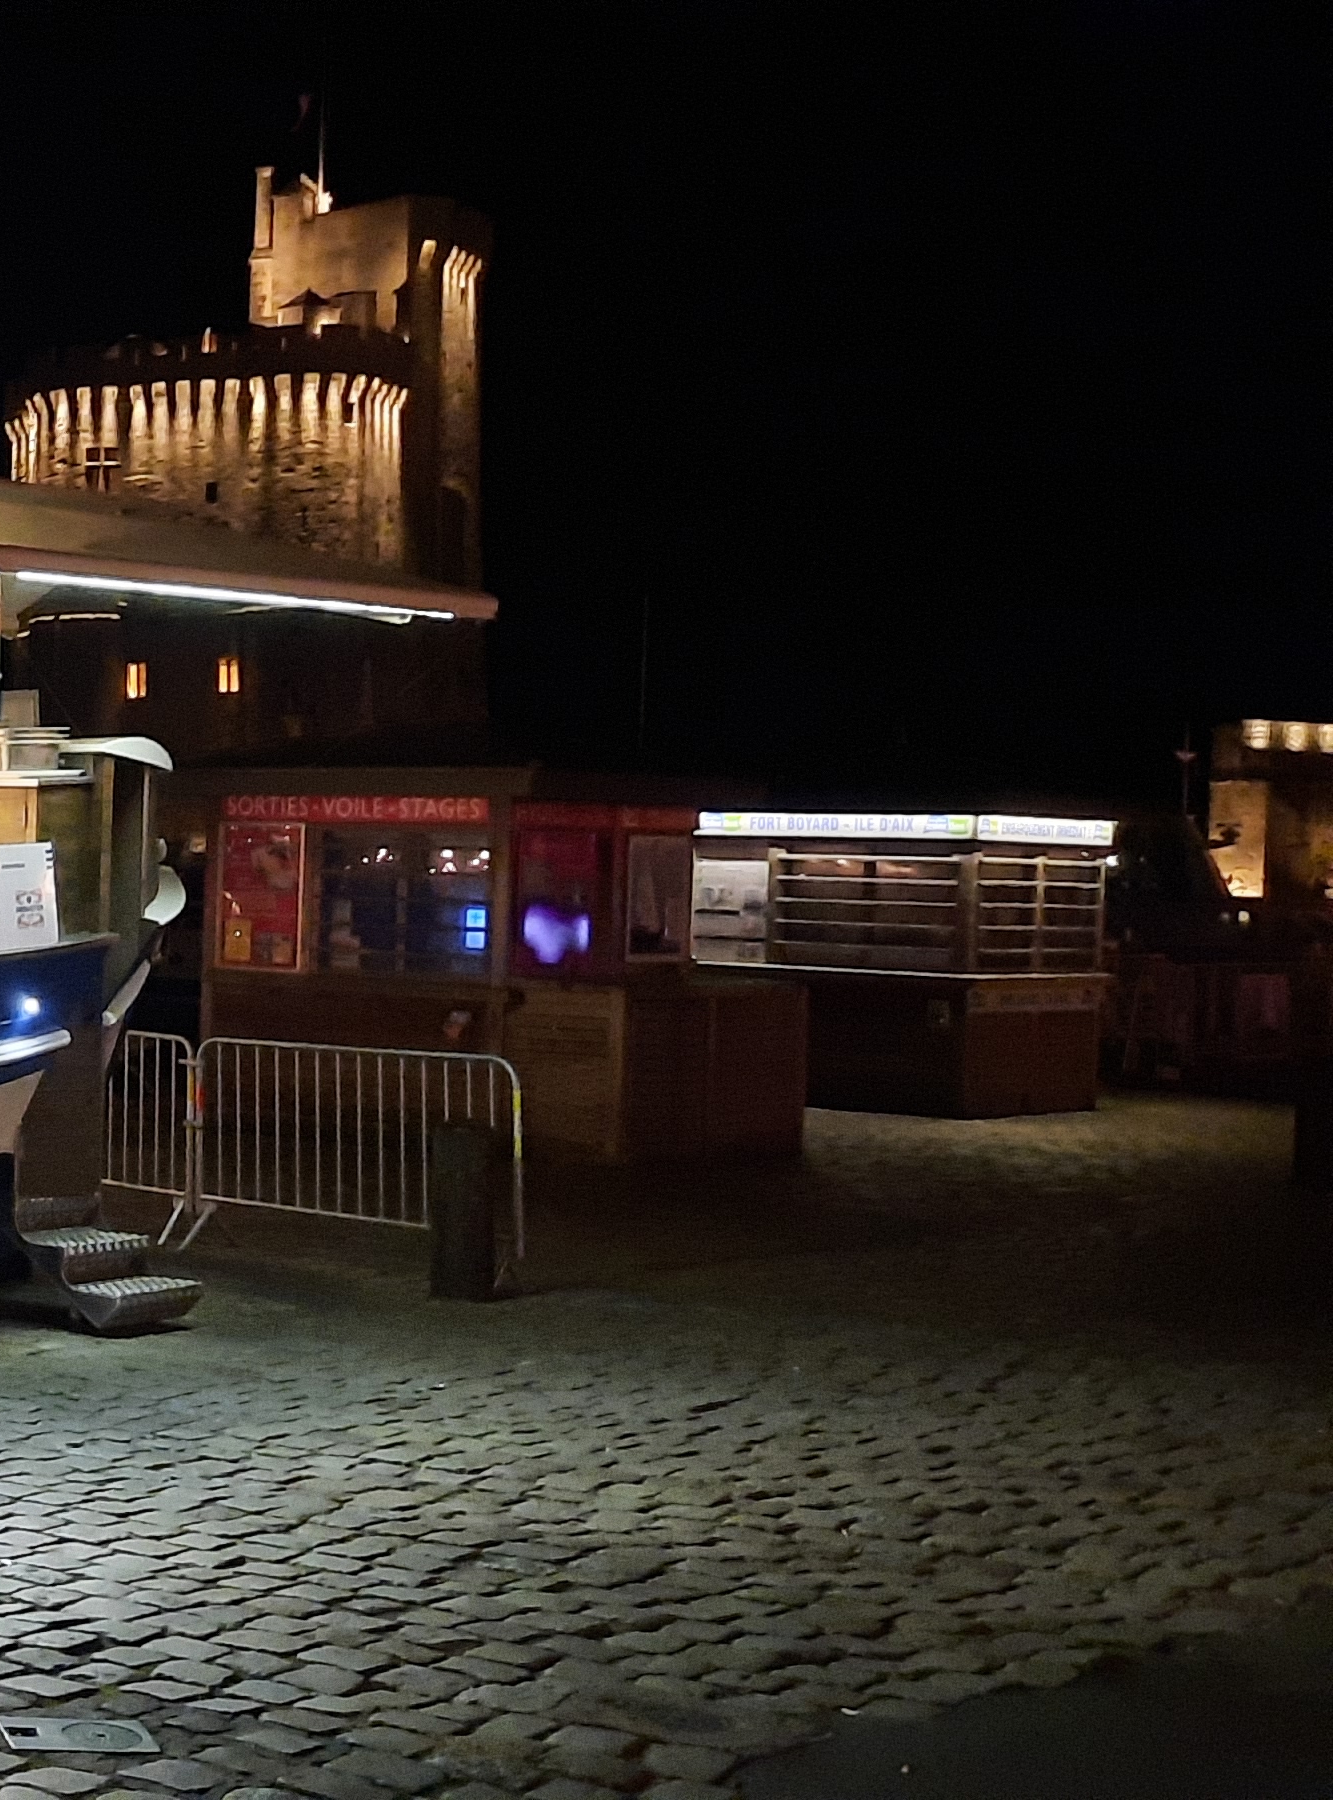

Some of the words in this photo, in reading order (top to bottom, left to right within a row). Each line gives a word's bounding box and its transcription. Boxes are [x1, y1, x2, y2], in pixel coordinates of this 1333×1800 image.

[225, 795, 309, 816] SORTIES
[321, 798, 383, 817] VOILE
[399, 798, 481, 820] STAGES
[749, 816, 783, 831] FORT
[787, 816, 840, 832] BOYARD
[854, 817, 874, 832] ILE
[880, 817, 915, 832] D'AIX
